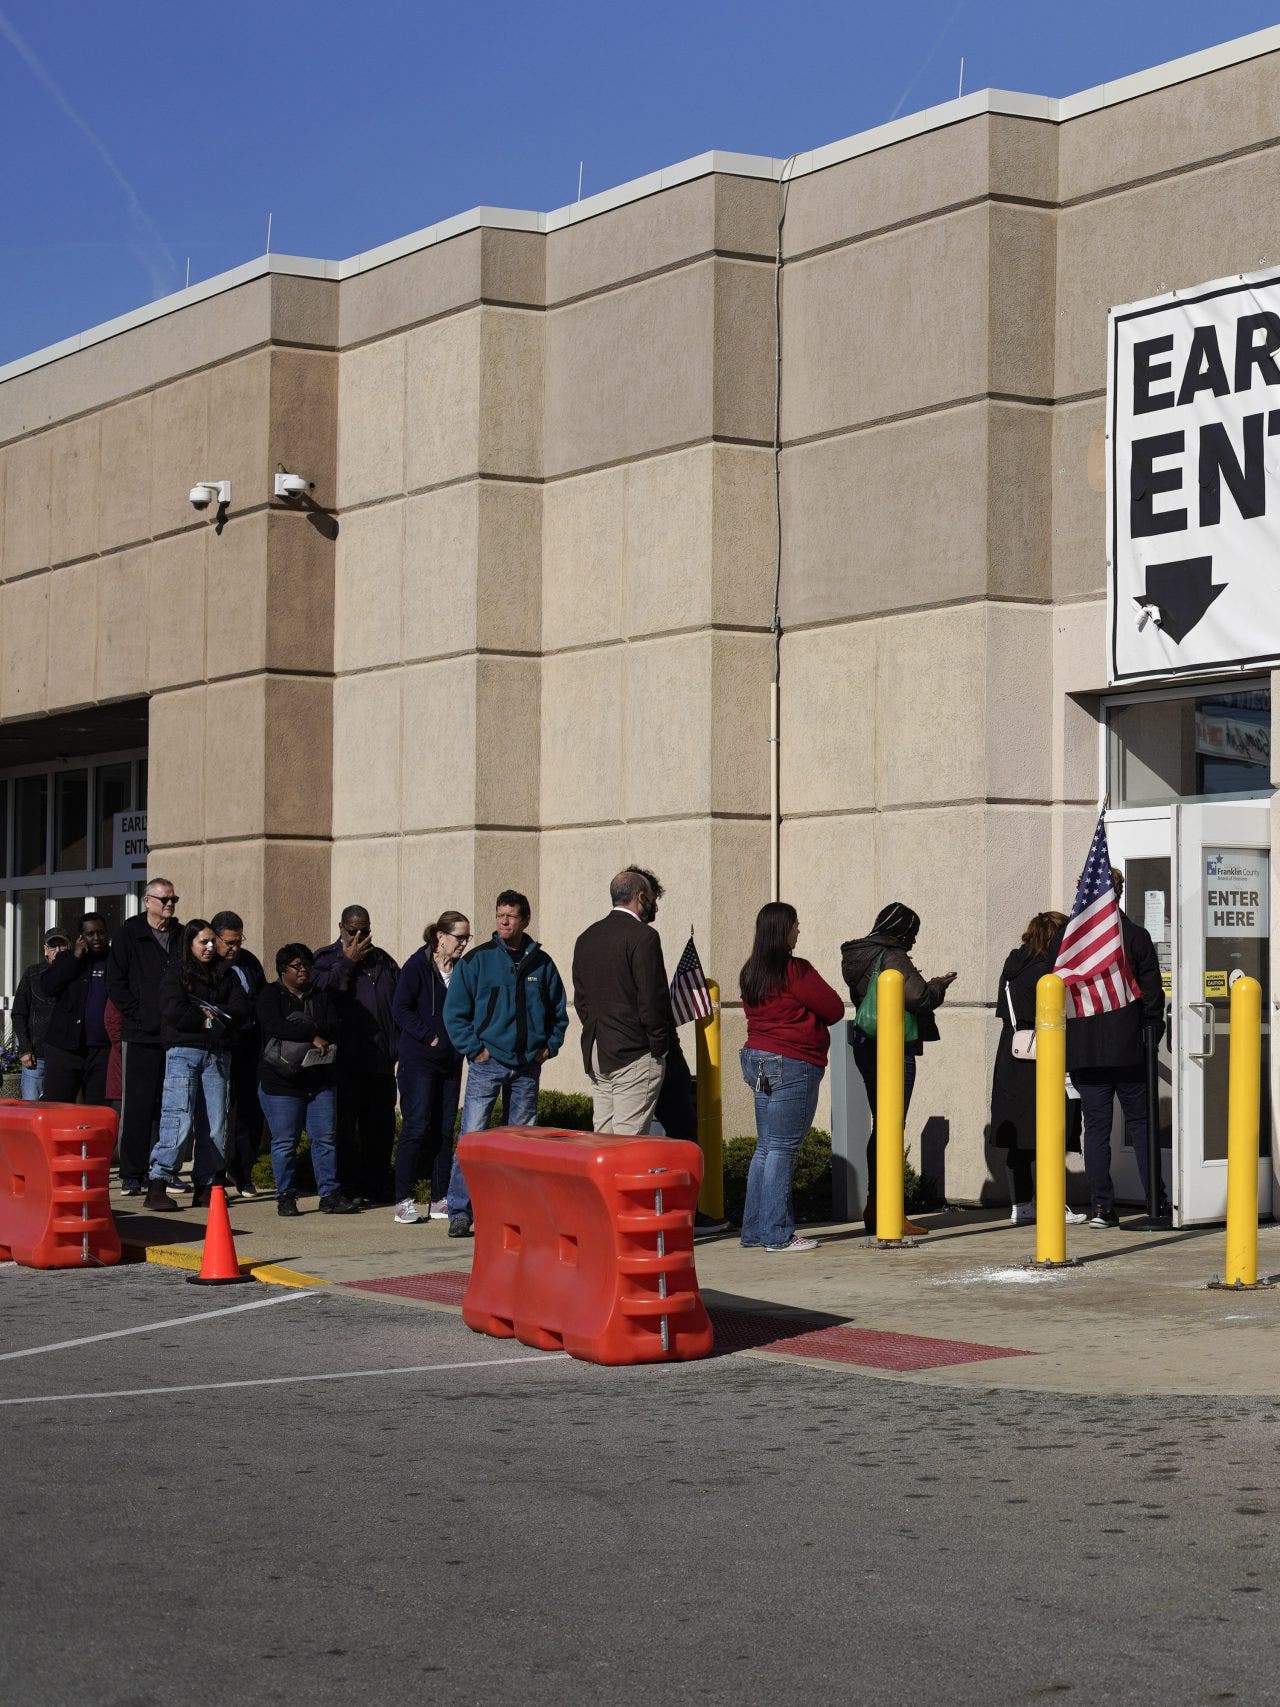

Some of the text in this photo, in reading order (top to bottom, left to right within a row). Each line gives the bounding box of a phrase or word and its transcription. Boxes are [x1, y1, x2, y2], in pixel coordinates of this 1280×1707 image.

[1217, 867, 1259, 877] Franklin County
[1208, 890, 1260, 906] ENTER
[1214, 911, 1255, 927] HERE
